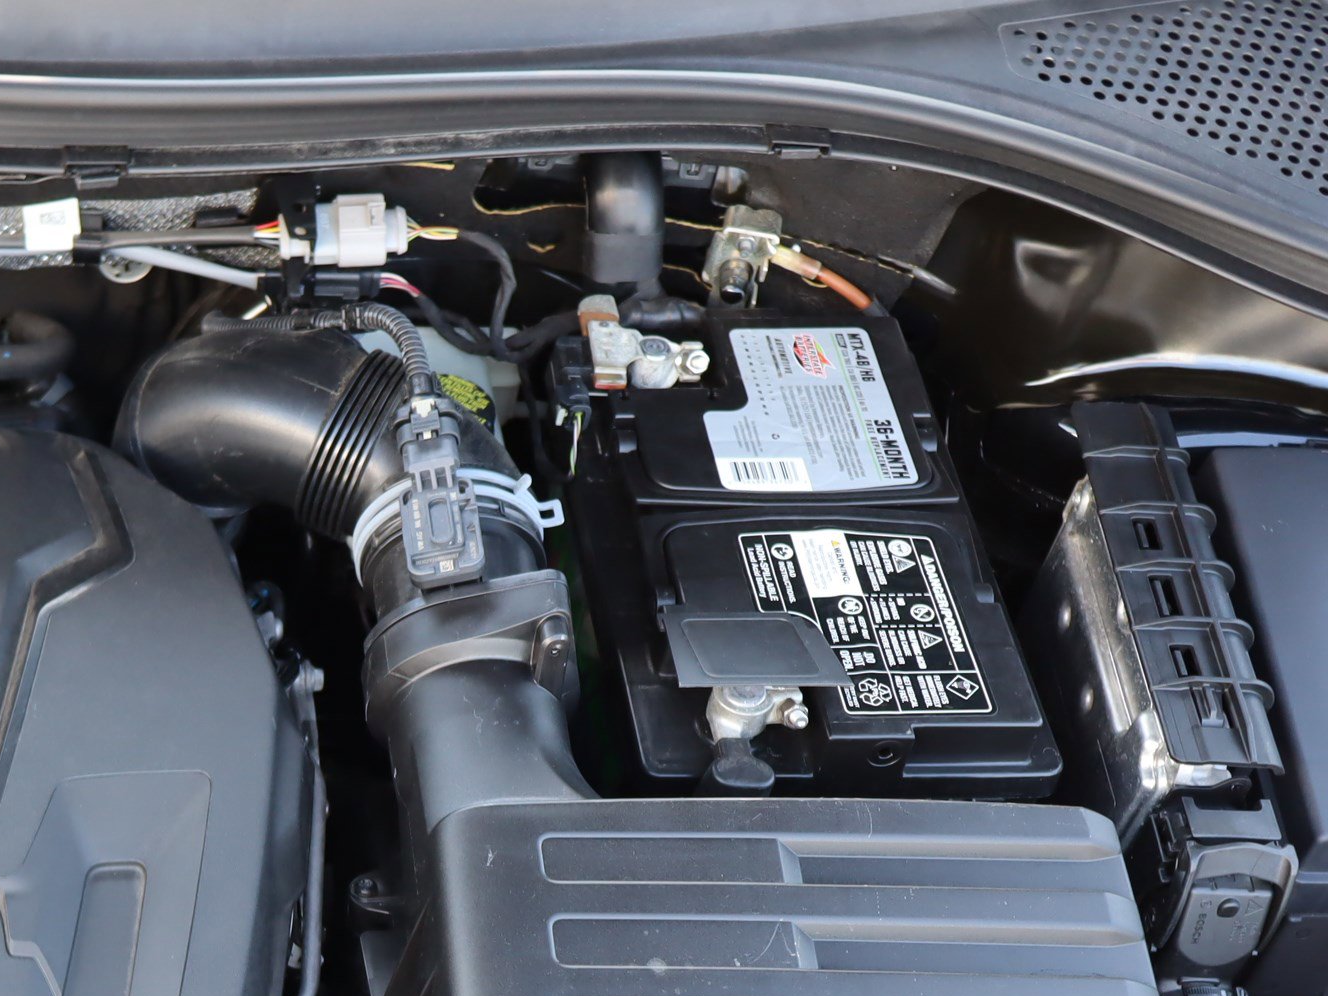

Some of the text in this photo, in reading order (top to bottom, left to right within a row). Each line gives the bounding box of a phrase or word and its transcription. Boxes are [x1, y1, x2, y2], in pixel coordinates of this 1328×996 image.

[773, 338, 793, 373] AUTOMOTIVE
[794, 336, 813, 371] BATTERIES
[802, 335, 823, 374] INTERSTATE
[864, 420, 891, 478] FREE REPLACEMENT
[873, 419, 910, 478] 36-MONTH
[785, 561, 797, 577] READ
[832, 547, 851, 583] WARNING:
[865, 540, 881, 567] EXPLOSIVE
[745, 547, 767, 597] Lead Acid Battery
[753, 544, 779, 601] NON-SPILLABLE
[776, 561, 796, 603] INSTRUCTIONS.
[835, 617, 848, 634] REACH
[923, 564, 965, 652] DANGER/POISON
[838, 650, 855, 671] OPEN.
[851, 652, 865, 665] NOT
[1191, 913, 1208, 944] BOSCH
